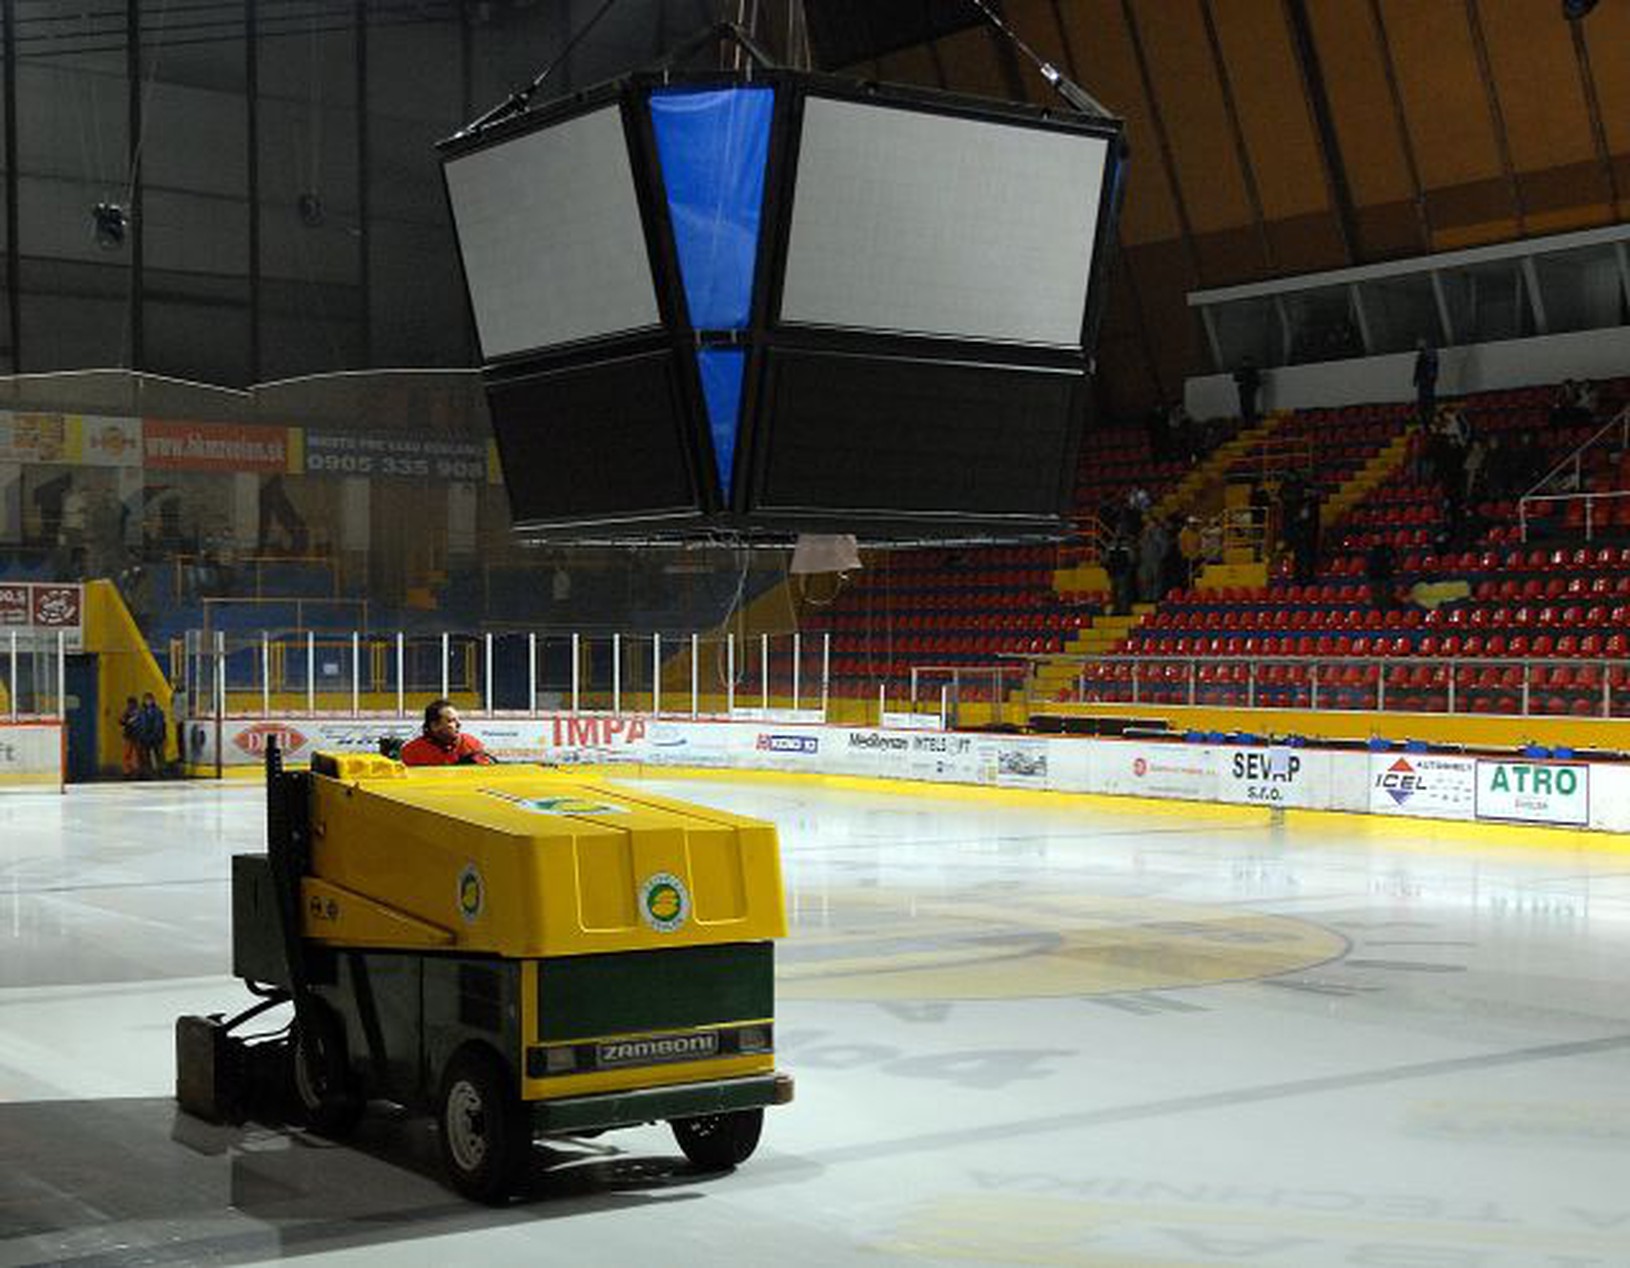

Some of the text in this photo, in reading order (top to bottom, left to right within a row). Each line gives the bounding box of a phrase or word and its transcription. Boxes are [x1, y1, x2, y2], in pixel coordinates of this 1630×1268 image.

[307, 453, 373, 473] 0905
[382, 456, 430, 475] 335
[552, 715, 648, 748] IMPA
[1375, 773, 1428, 791] ICEL
[1490, 765, 1578, 796] ATRO
[603, 1035, 714, 1061] ZAMBONI
